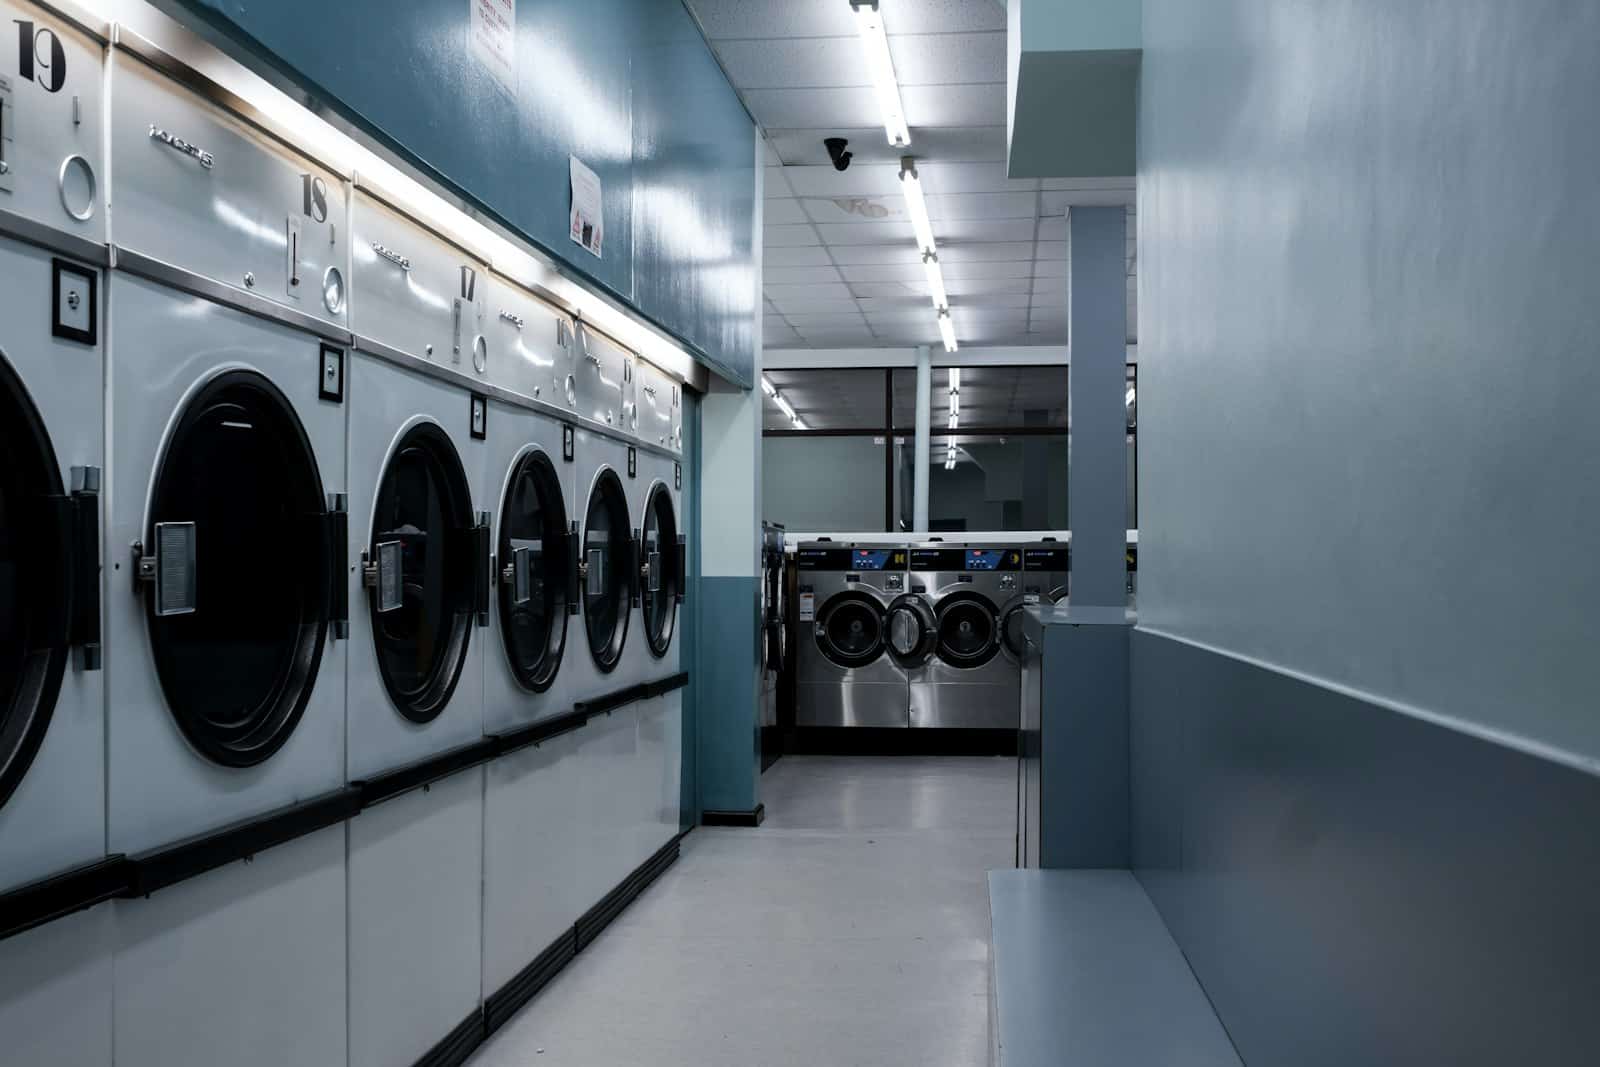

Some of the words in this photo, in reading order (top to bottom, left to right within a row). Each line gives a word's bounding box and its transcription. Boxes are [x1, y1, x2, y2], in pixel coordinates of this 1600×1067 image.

[13, 20, 66, 93] 19
[301, 174, 328, 223] 18
[460, 265, 476, 302] 17
